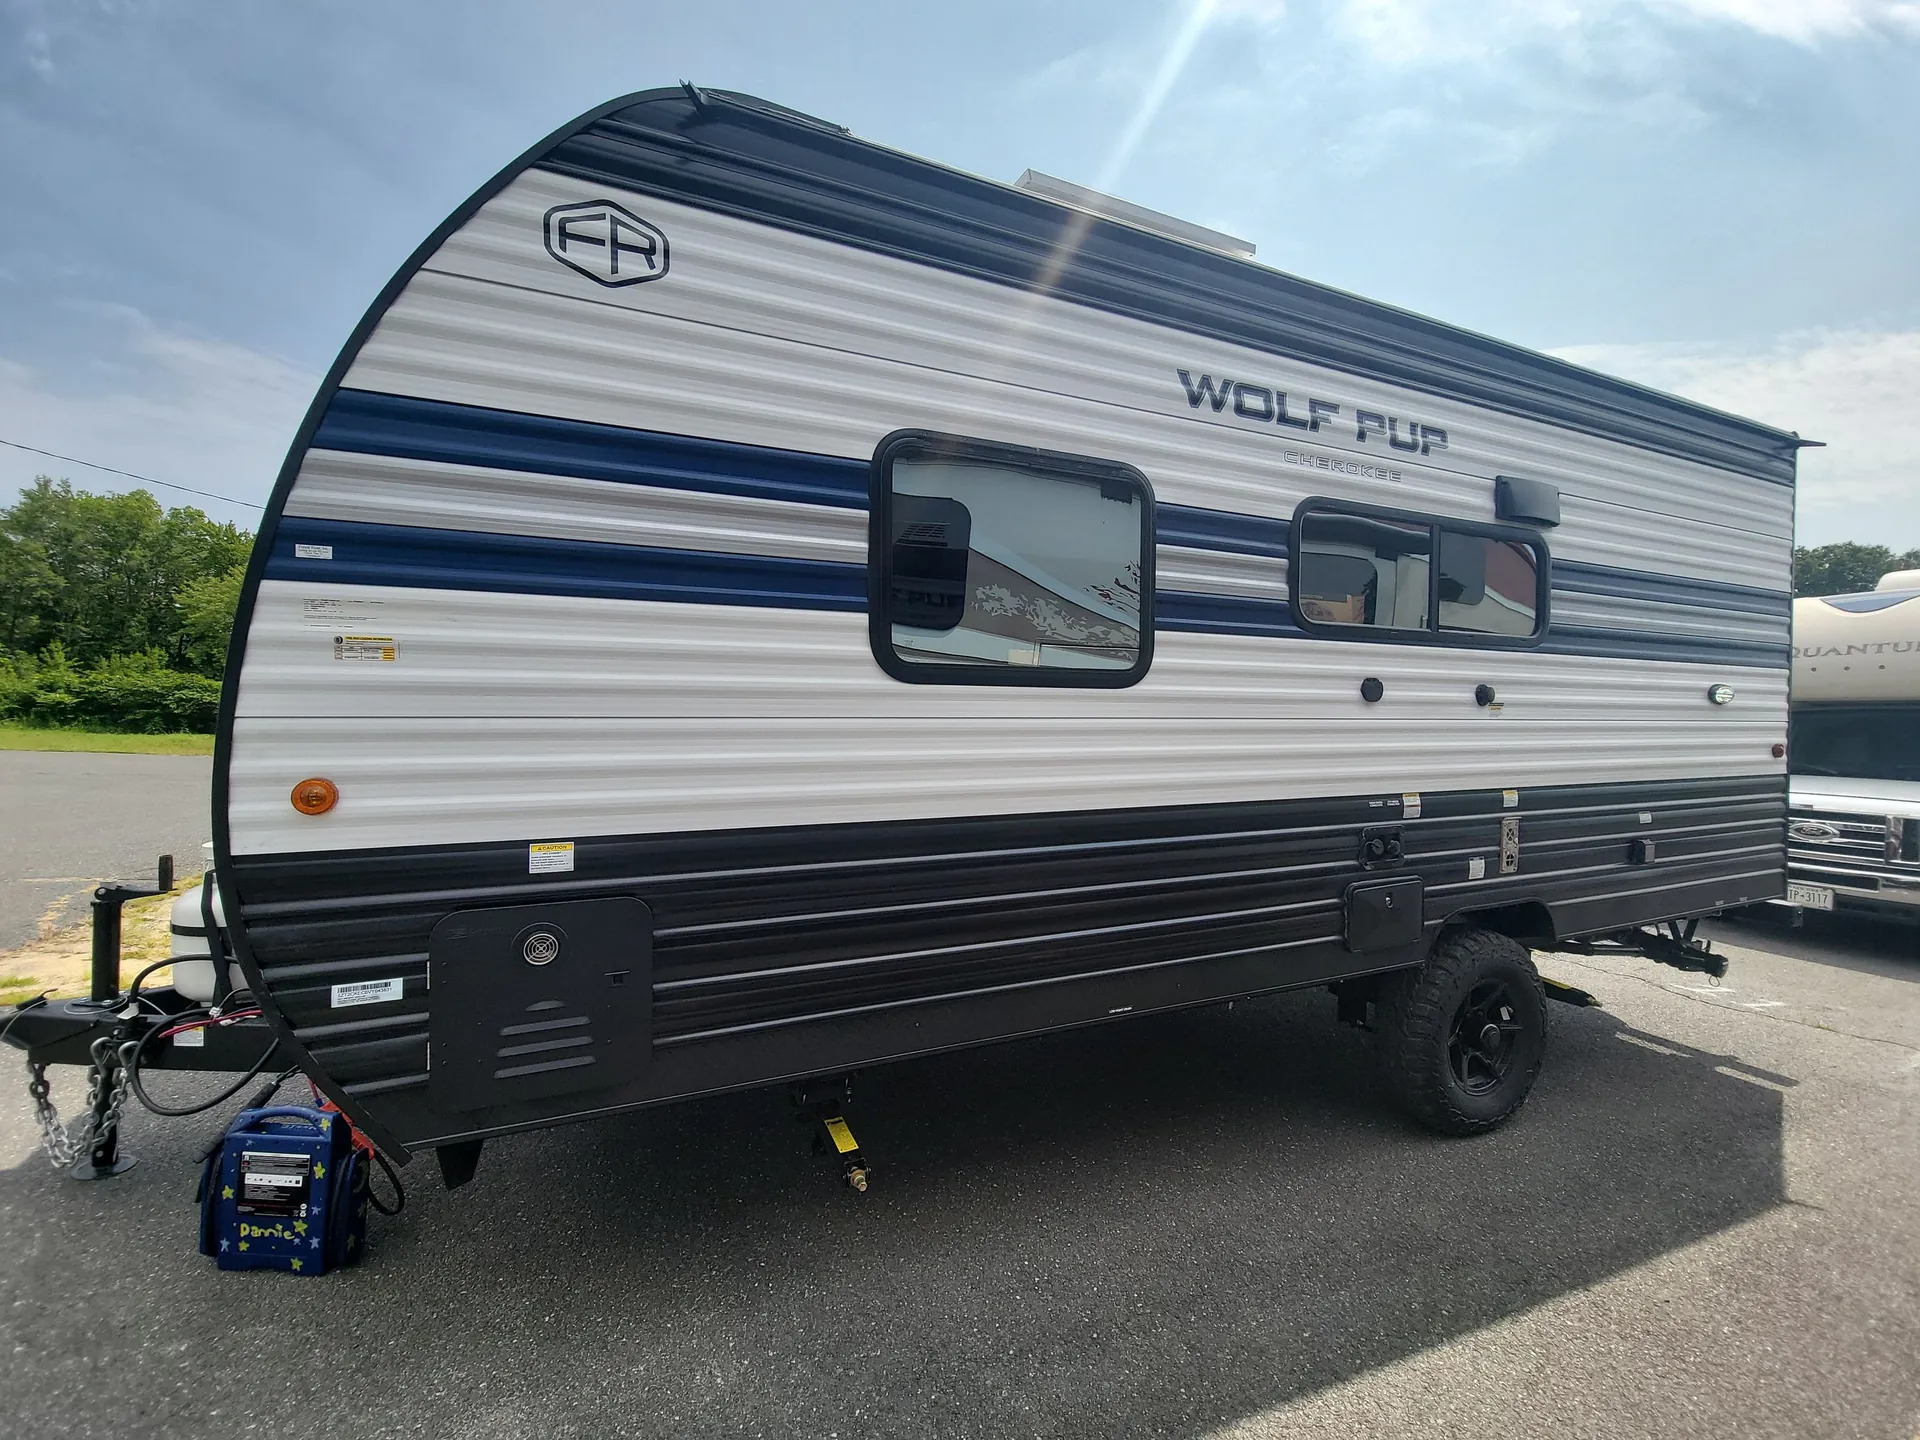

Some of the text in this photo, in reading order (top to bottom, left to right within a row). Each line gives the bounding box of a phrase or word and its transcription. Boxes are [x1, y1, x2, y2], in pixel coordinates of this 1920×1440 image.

[1176, 368, 1449, 457] WOLF PUP
[1283, 450, 1402, 483] CHEROKEE
[1792, 641, 1920, 659] UANTU
